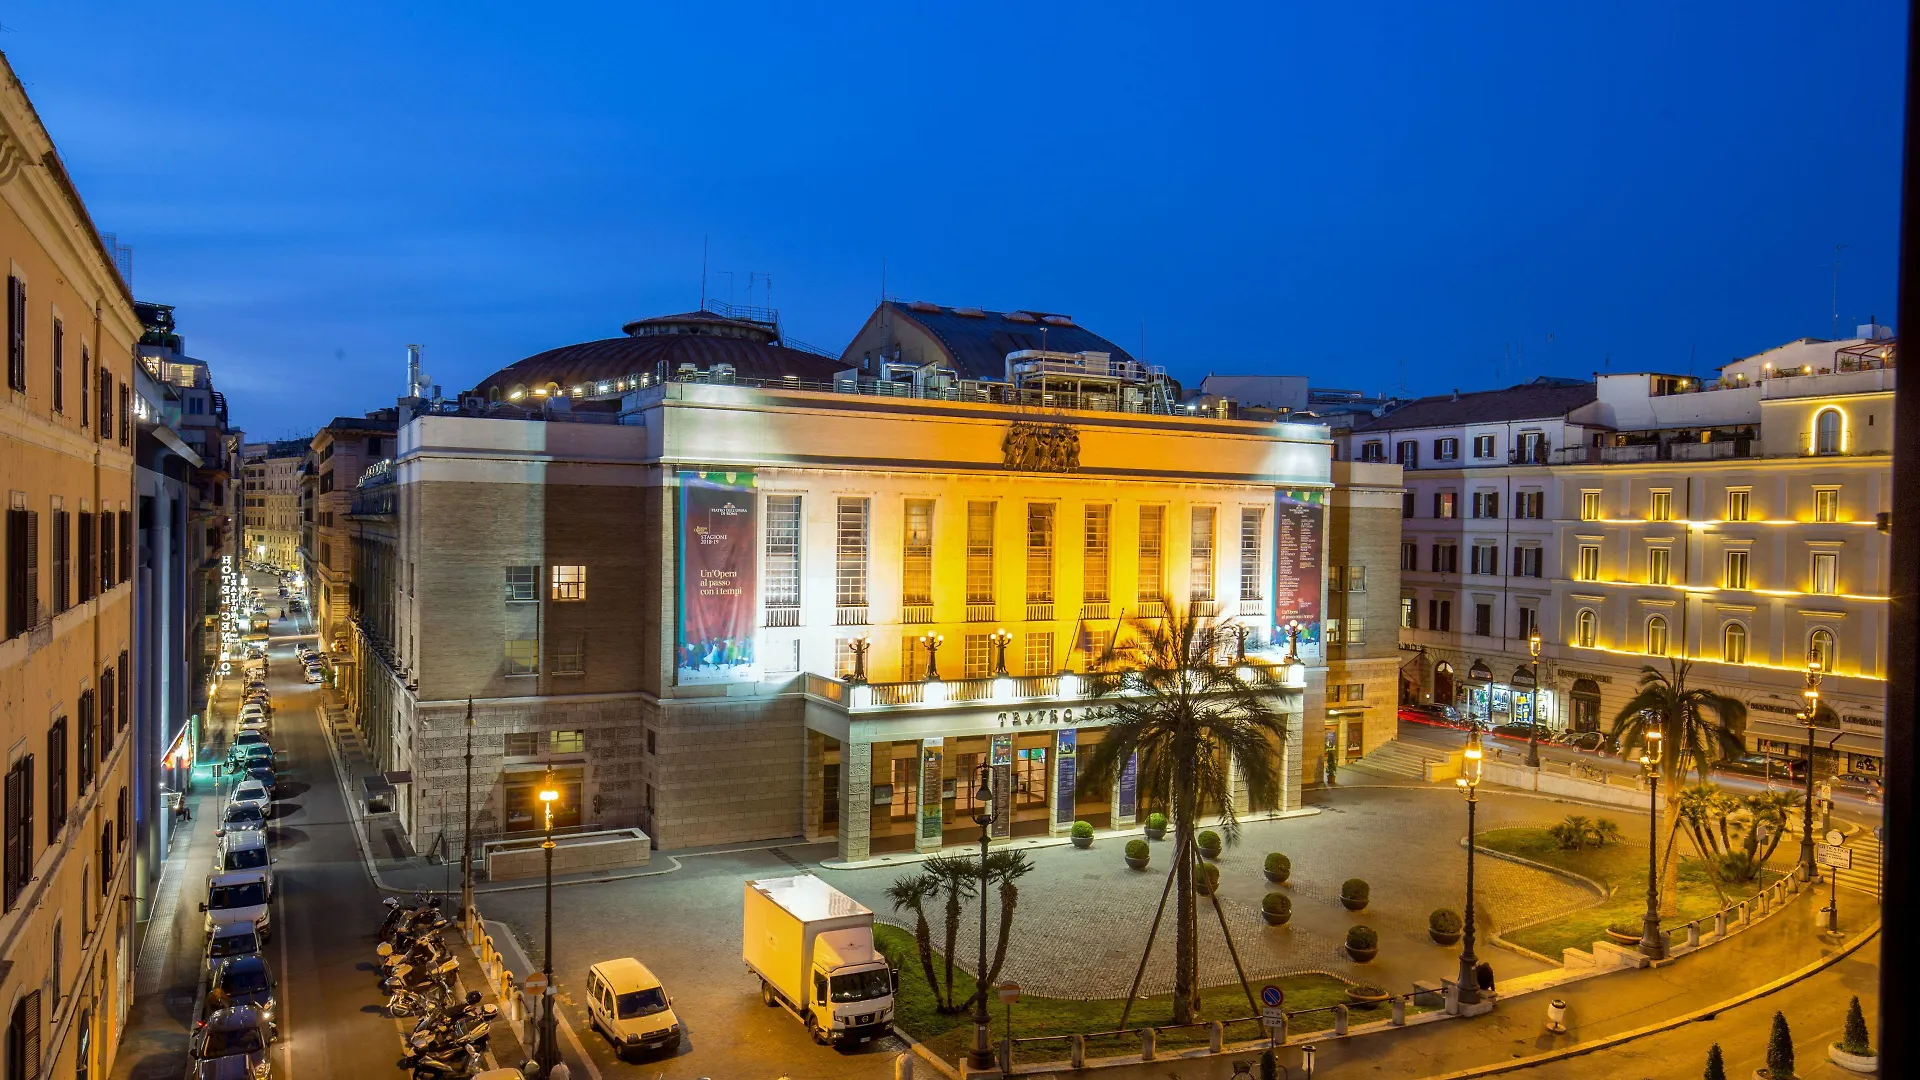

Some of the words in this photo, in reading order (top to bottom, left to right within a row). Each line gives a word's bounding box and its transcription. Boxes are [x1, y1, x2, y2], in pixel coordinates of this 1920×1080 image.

[700, 570, 737, 579] Un'Opera
[700, 578, 707, 586] al
[709, 579, 731, 588] passo
[720, 586, 742, 597] tempi
[997, 708, 1072, 728] TEATRO
